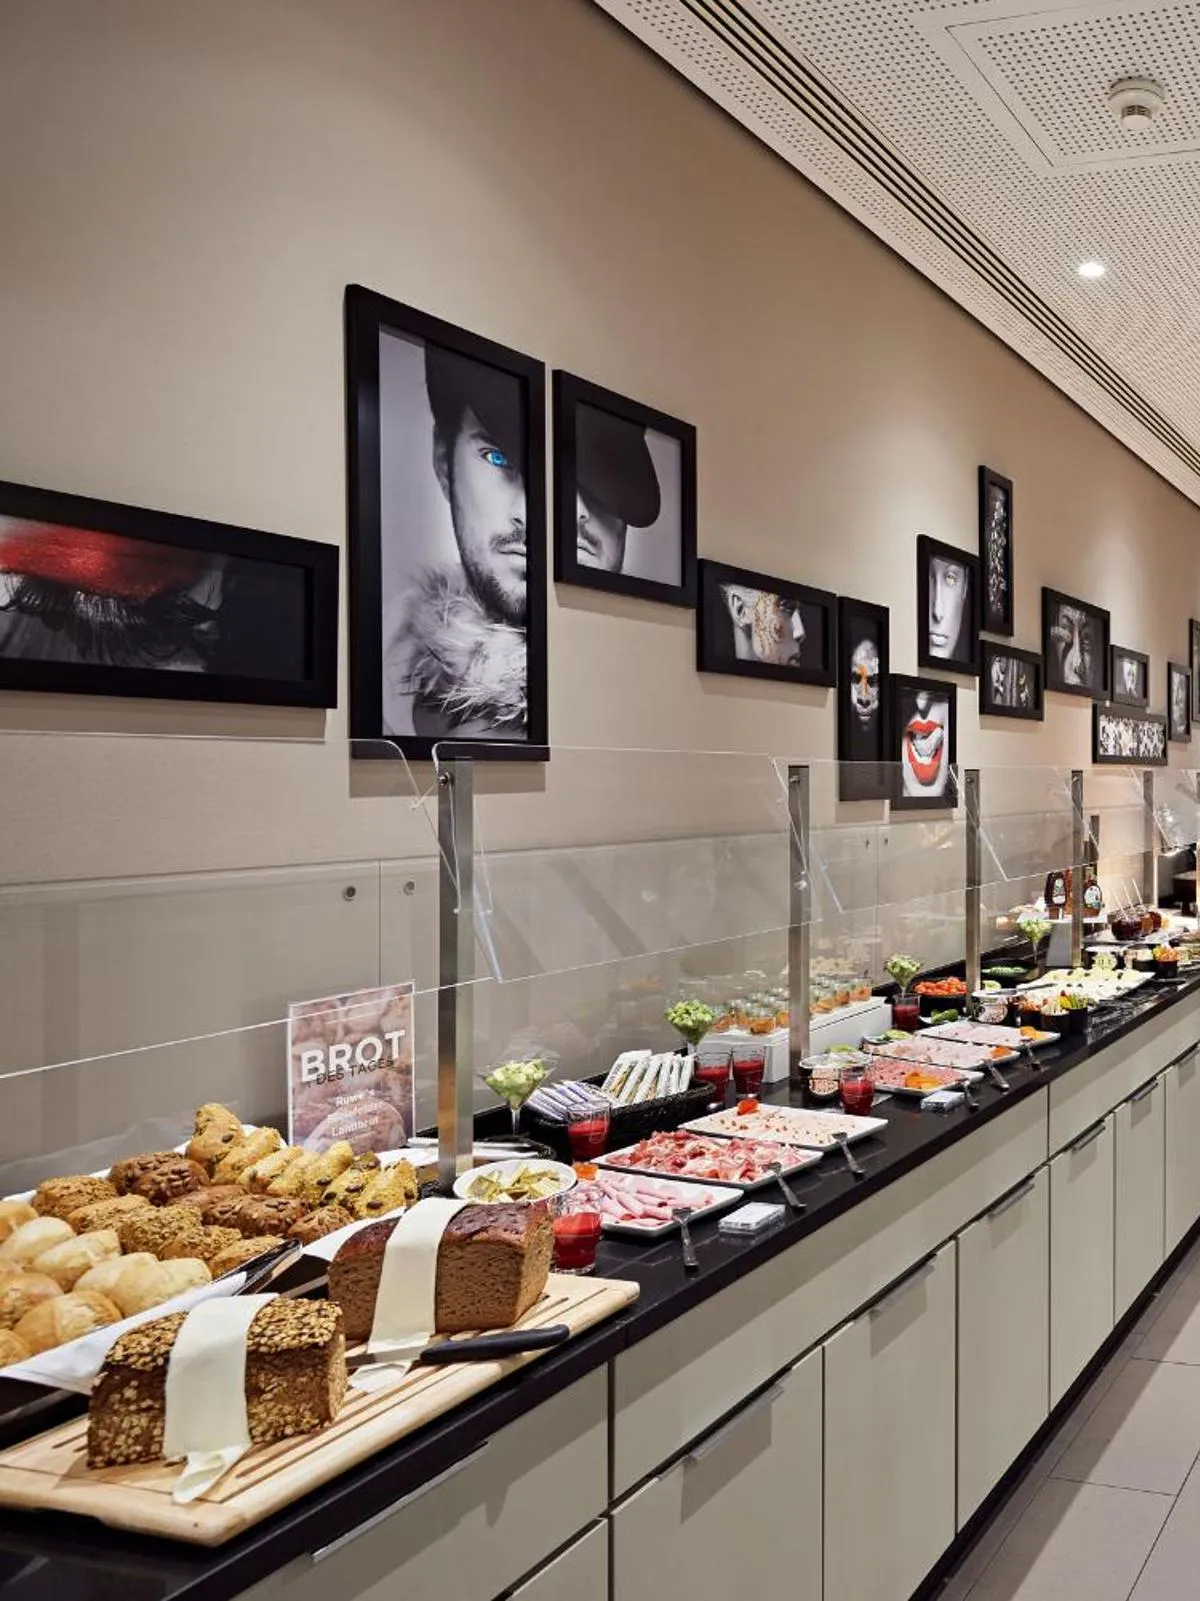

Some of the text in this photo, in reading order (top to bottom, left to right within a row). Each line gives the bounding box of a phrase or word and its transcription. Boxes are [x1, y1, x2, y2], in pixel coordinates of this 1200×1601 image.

[301, 1030, 405, 1082] BROT
[316, 1056, 395, 1085] DES TAGES
